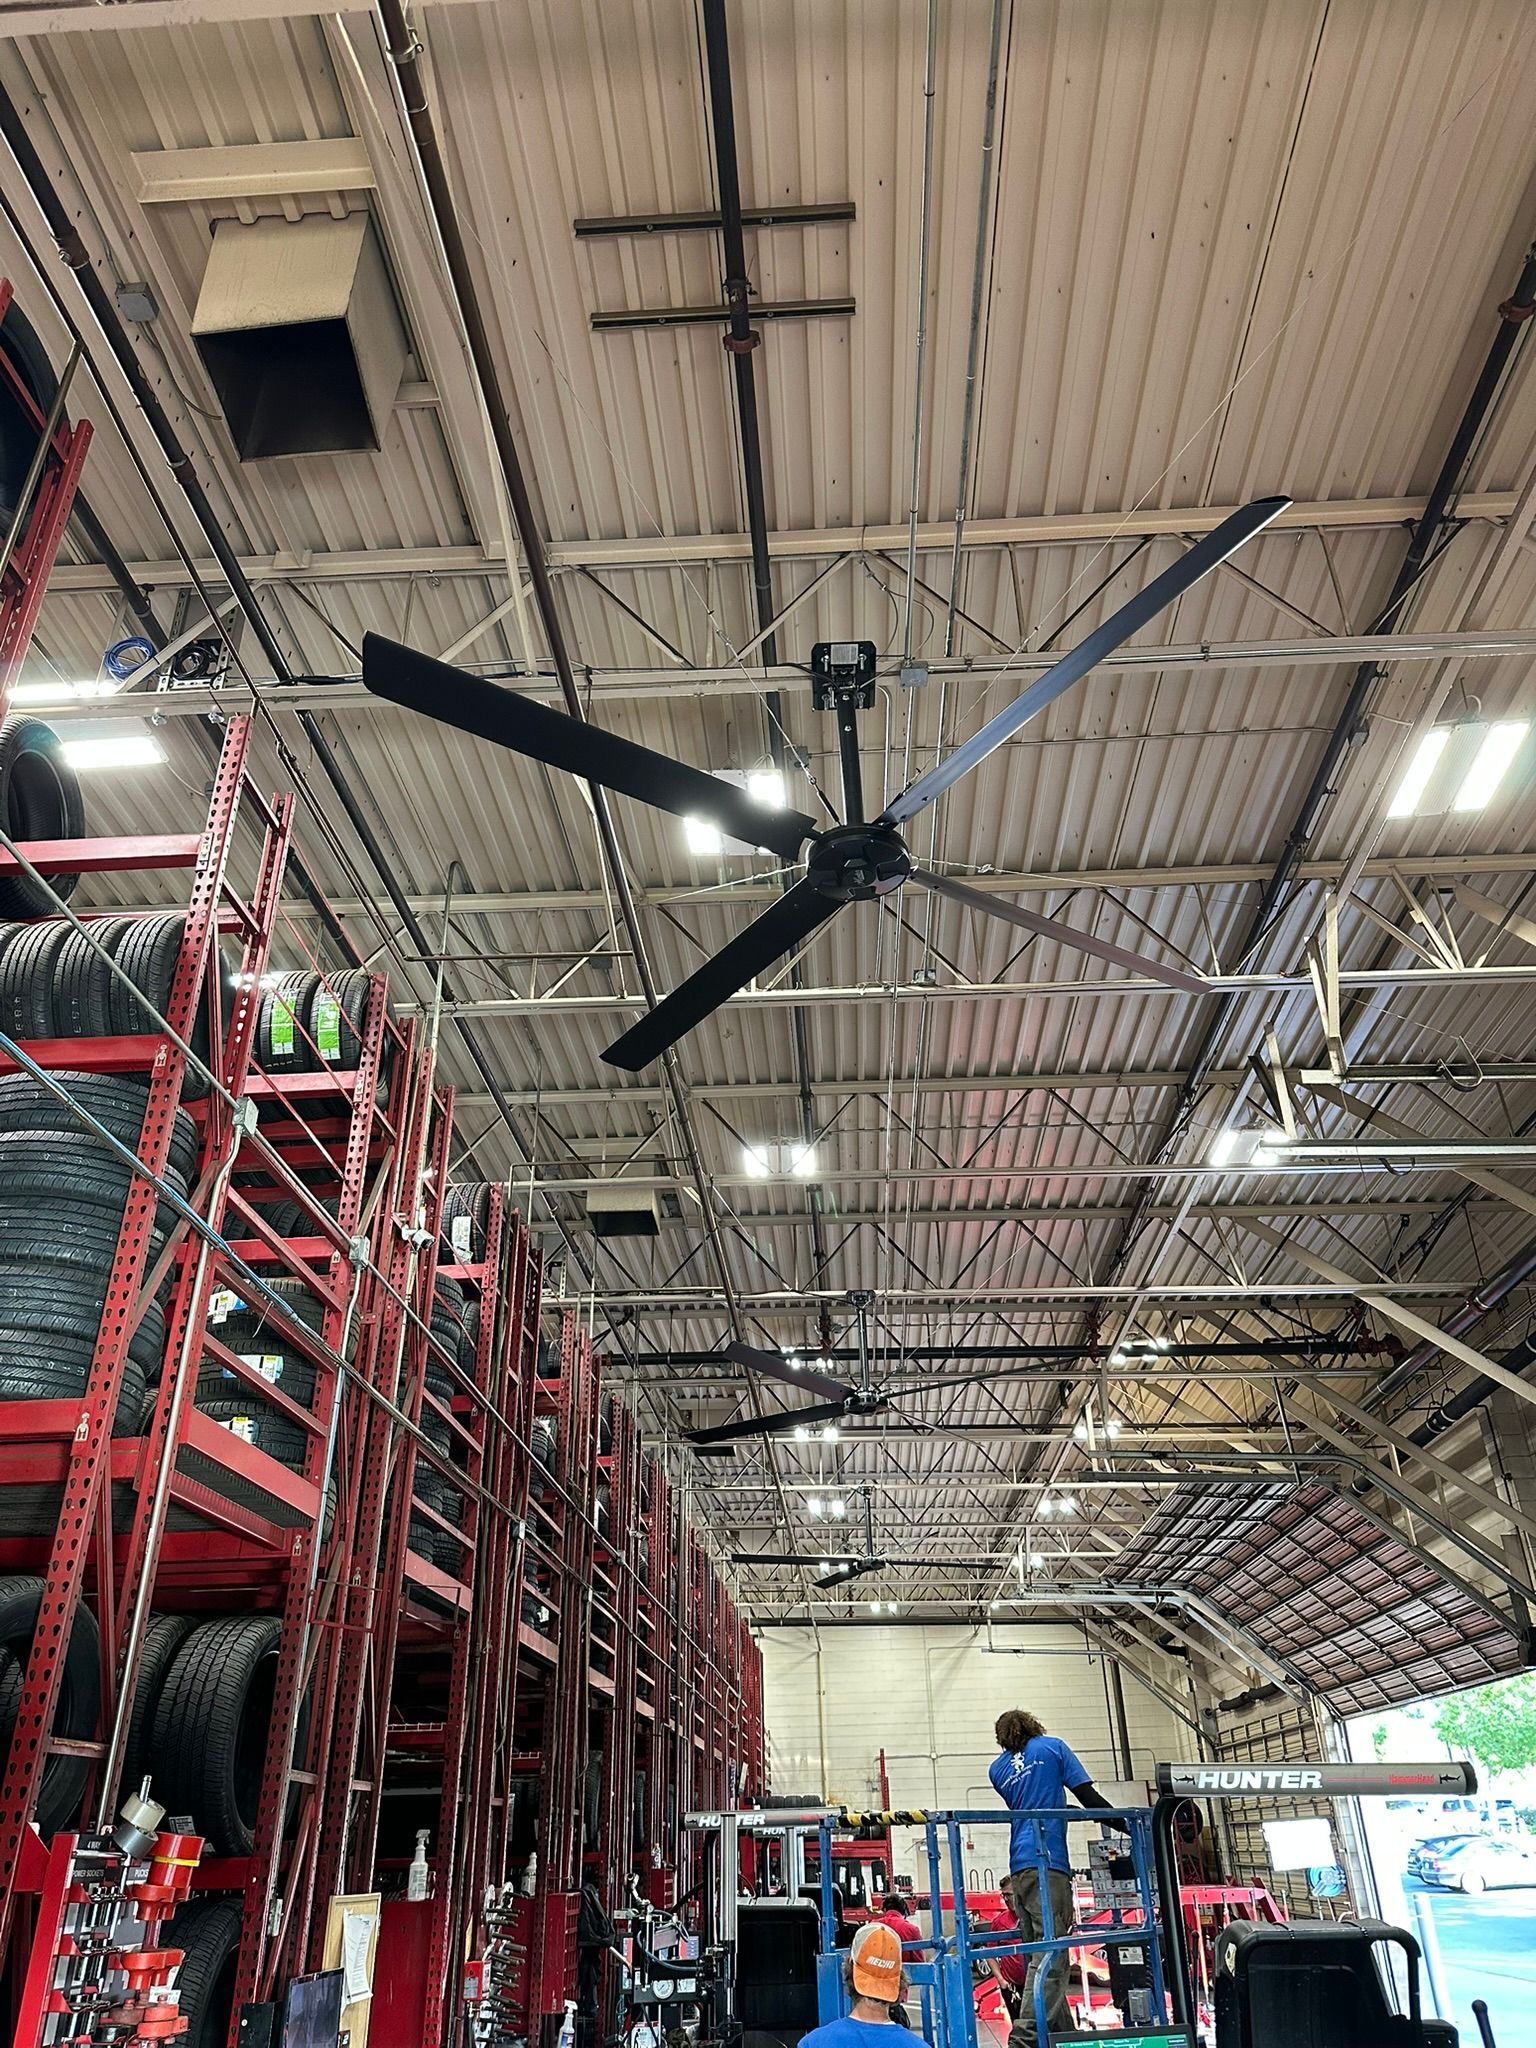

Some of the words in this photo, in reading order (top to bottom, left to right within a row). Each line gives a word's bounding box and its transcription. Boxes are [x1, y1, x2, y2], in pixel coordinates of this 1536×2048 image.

[1197, 1770, 1322, 1789] HUNTER
[698, 1813, 766, 1827] HUTER
[763, 1826, 809, 1835] HUNER
